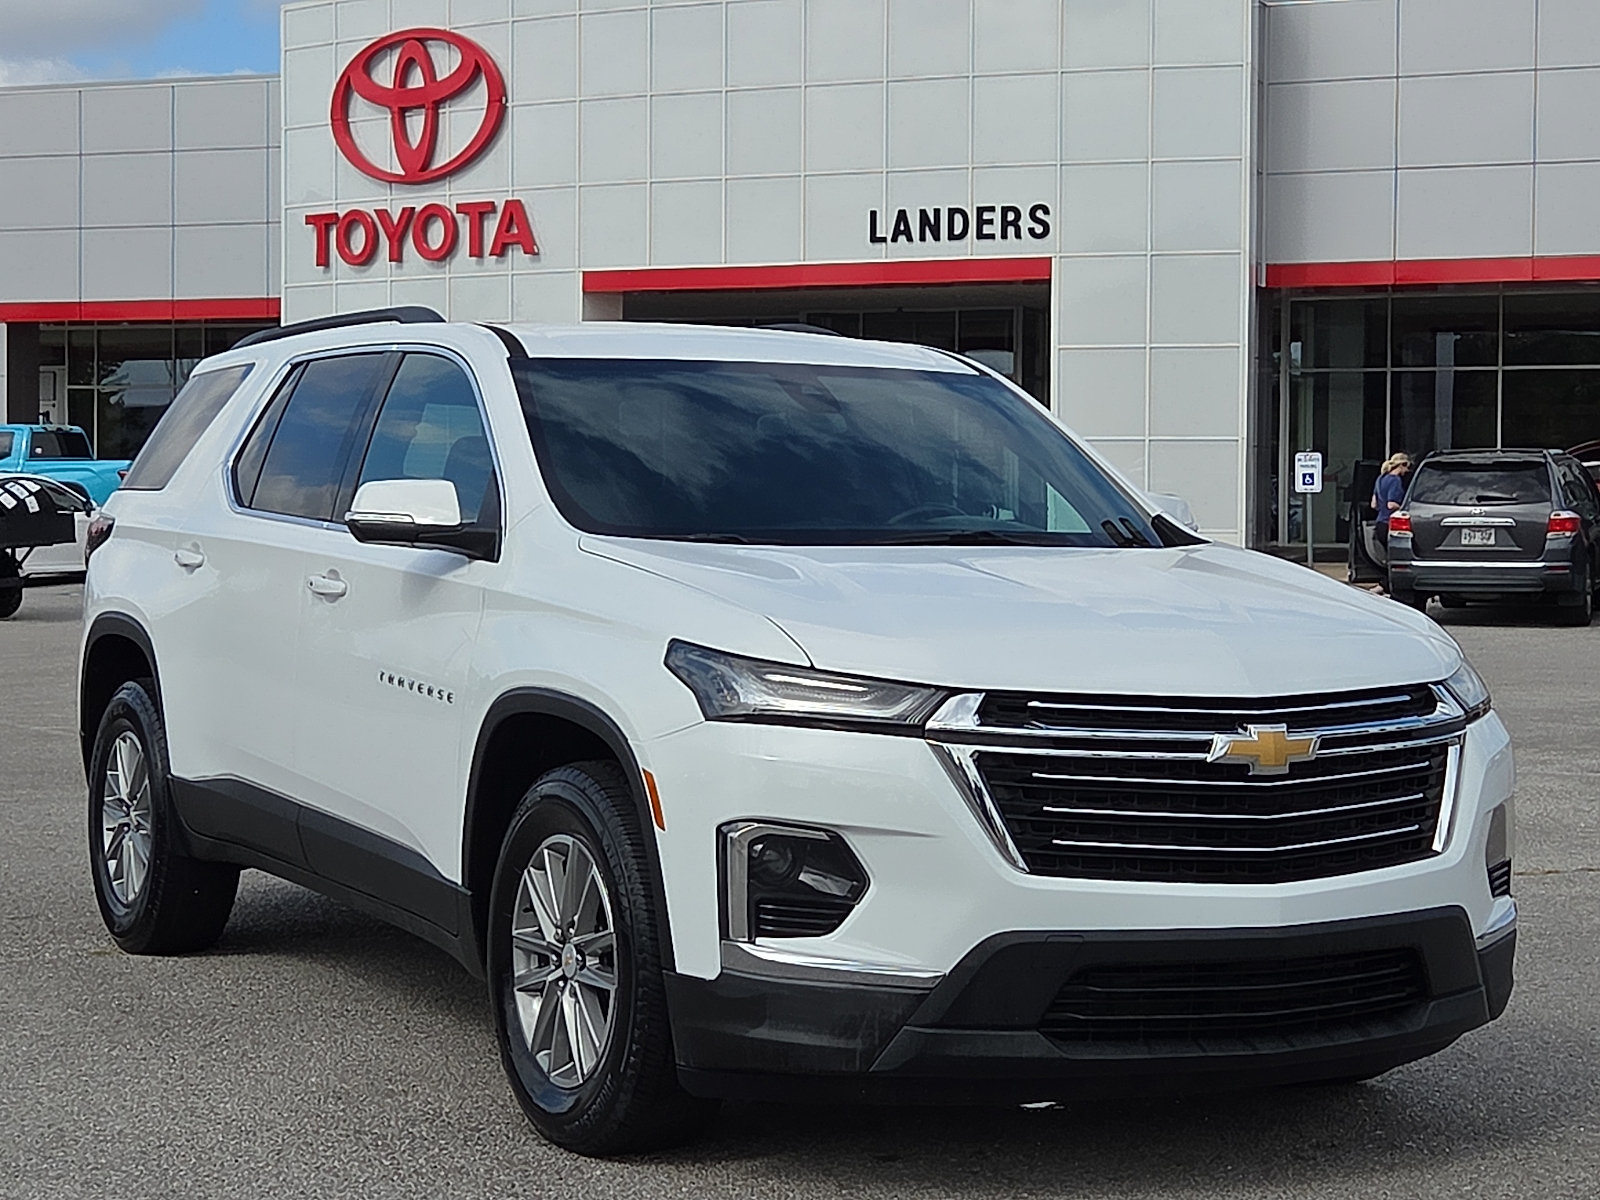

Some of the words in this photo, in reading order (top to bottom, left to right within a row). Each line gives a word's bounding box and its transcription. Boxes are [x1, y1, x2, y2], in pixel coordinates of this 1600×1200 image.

[305, 199, 539, 267] TOYOTA
[869, 203, 1051, 244] LANDERS
[379, 670, 455, 704] TRAVERSE
